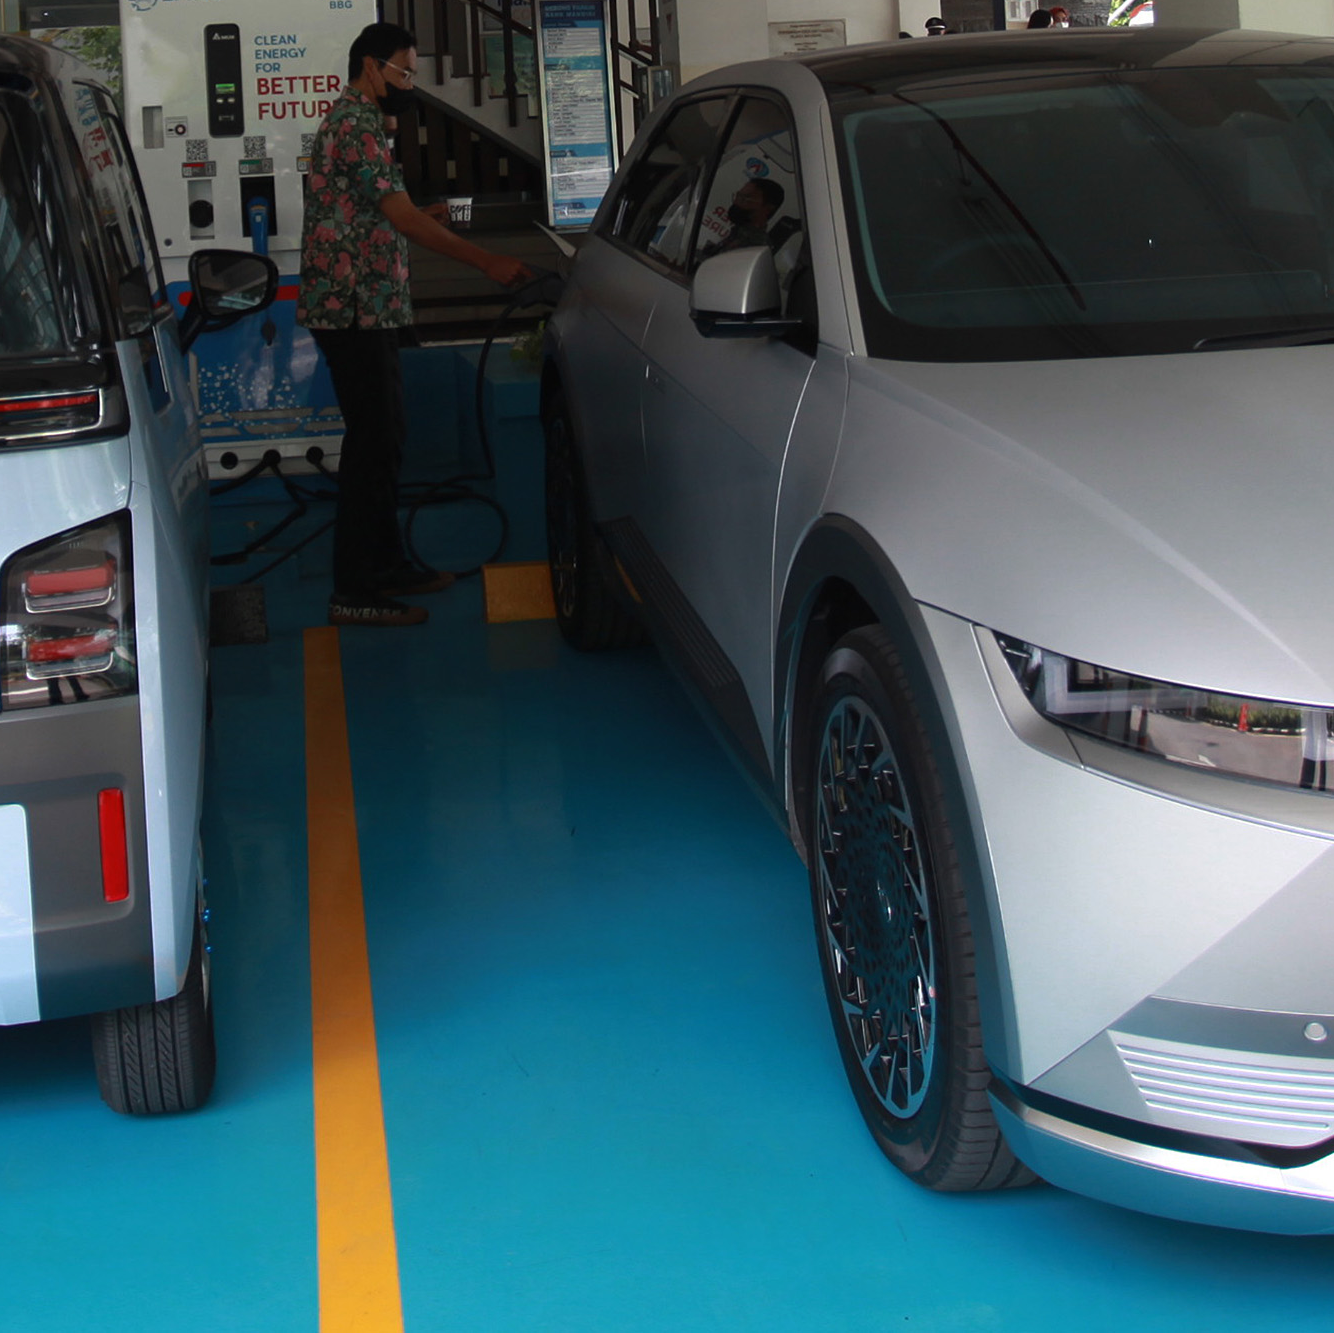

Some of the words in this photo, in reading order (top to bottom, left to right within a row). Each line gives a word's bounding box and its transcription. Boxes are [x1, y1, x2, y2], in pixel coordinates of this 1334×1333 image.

[329, 0, 353, 9] BBG
[254, 34, 297, 46] CLEAN
[255, 47, 306, 60] ENERGY
[256, 62, 281, 74] FOR
[256, 74, 341, 96] BETTER
[258, 100, 333, 120] FUTUR
